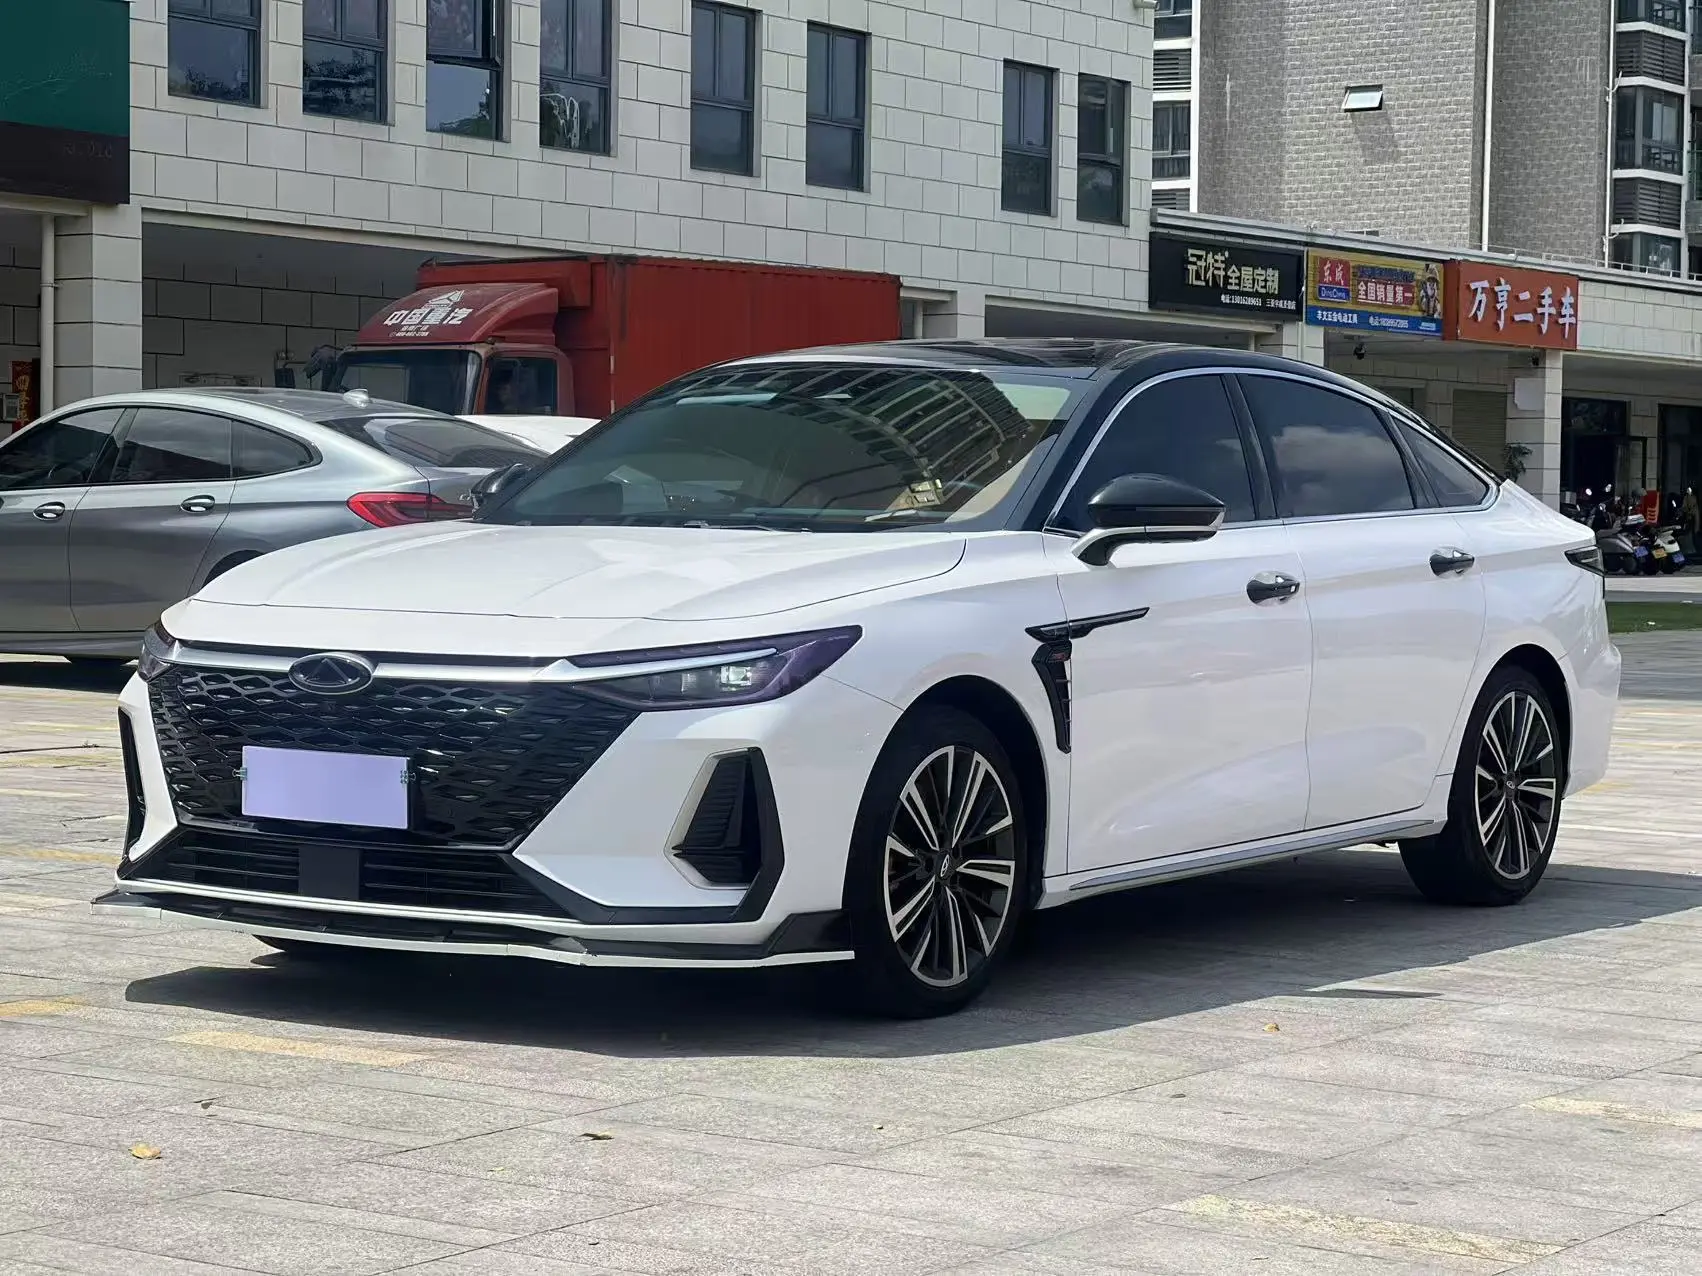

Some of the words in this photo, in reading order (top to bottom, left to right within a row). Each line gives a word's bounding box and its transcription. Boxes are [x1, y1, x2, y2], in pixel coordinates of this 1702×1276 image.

[1188, 249, 1226, 287] 冠特
[1227, 264, 1279, 294] 全屋定制
[1358, 281, 1413, 304] 全国销量第一
[1468, 277, 1576, 339] 万亨二手车
[383, 307, 473, 326] 中国重汽
